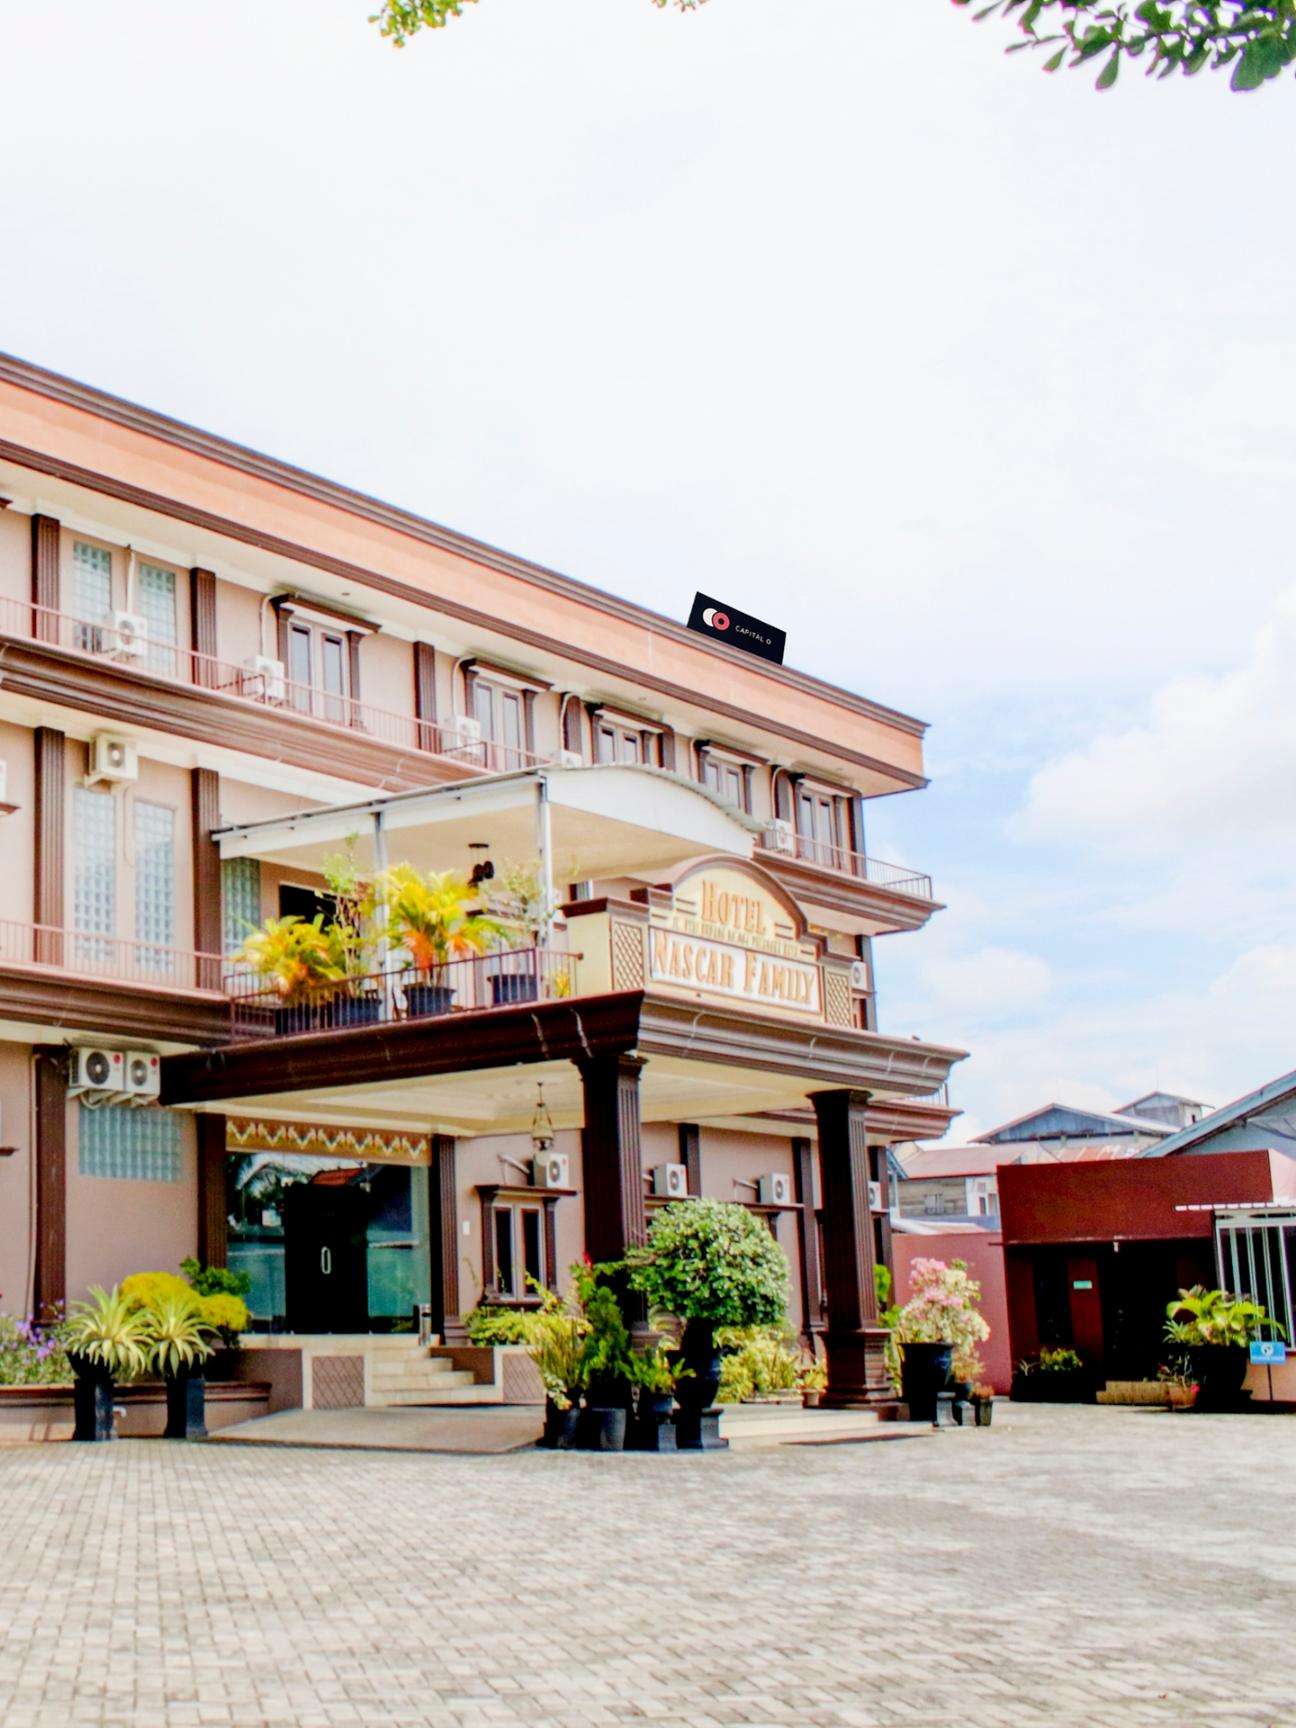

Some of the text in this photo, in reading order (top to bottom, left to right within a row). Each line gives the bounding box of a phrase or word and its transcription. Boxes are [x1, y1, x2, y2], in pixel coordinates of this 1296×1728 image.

[735, 625, 764, 642] CAPITAL
[701, 880, 766, 934] HOTEL
[654, 931, 735, 987] NASCAR
[744, 950, 814, 1003] FAMILY
